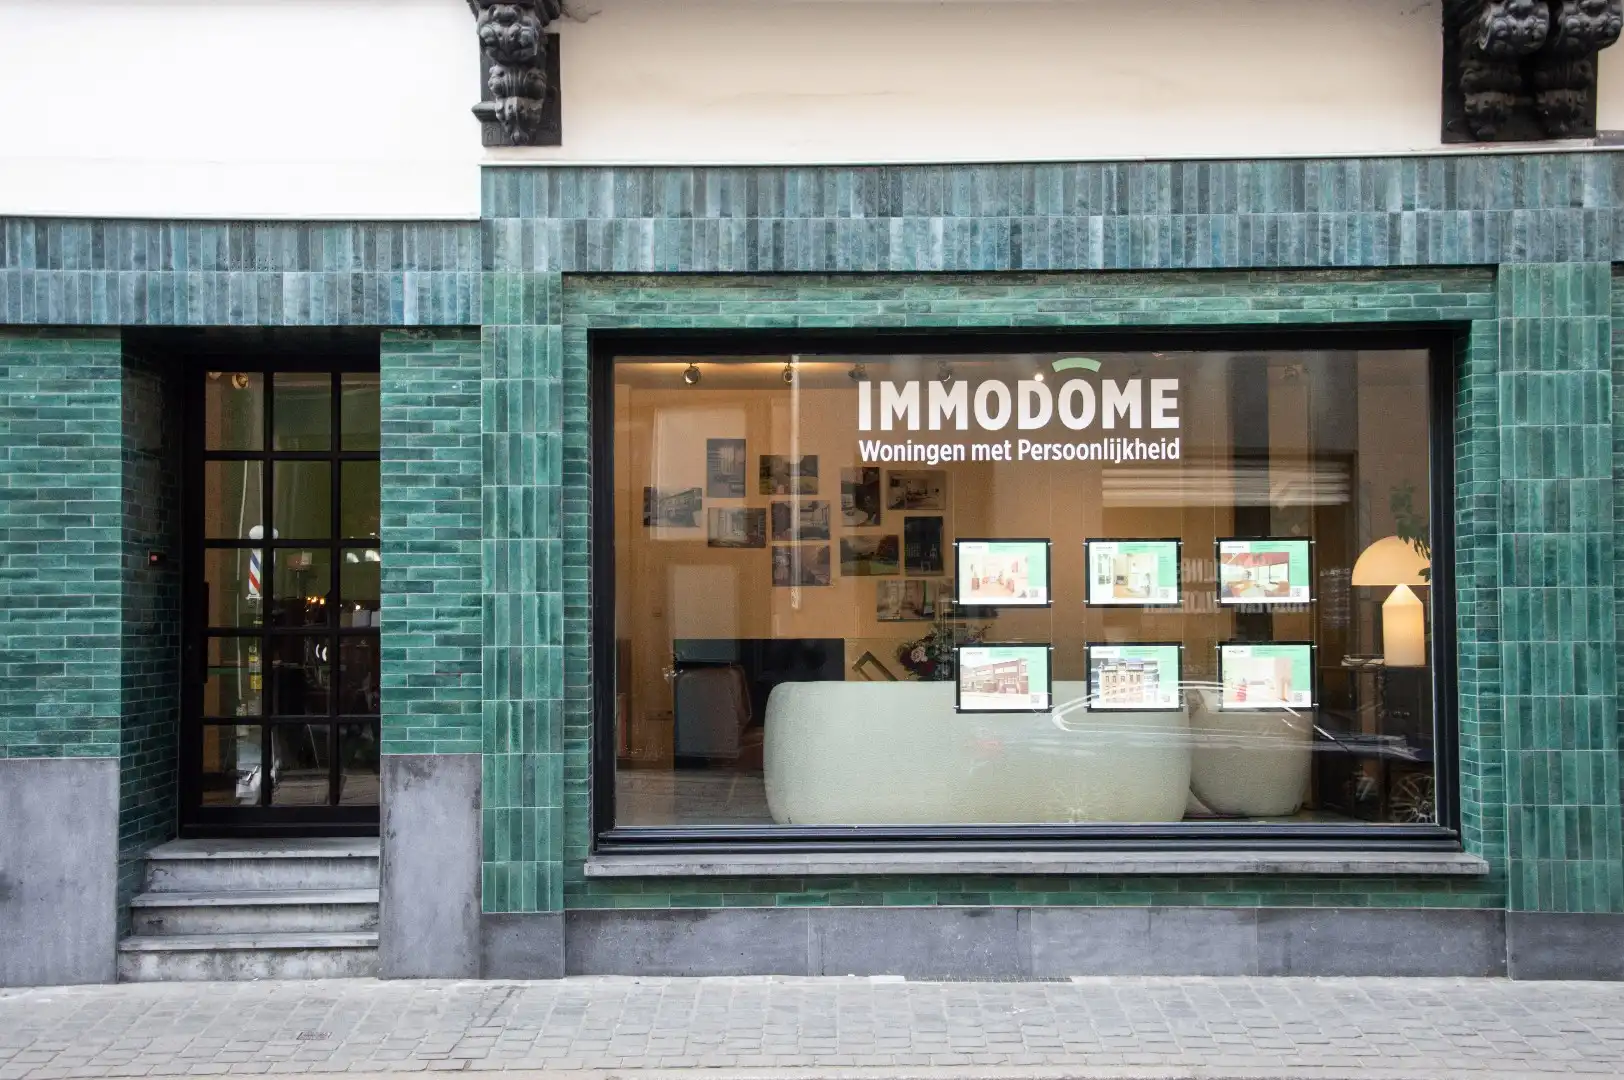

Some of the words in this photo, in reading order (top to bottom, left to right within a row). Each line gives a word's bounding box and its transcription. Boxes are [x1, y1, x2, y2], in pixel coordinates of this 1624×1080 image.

[858, 378, 1180, 431] IMMODOME
[858, 438, 965, 465] Woningen
[971, 439, 1012, 461] met
[1017, 437, 1180, 464] Persoonlijkheid
